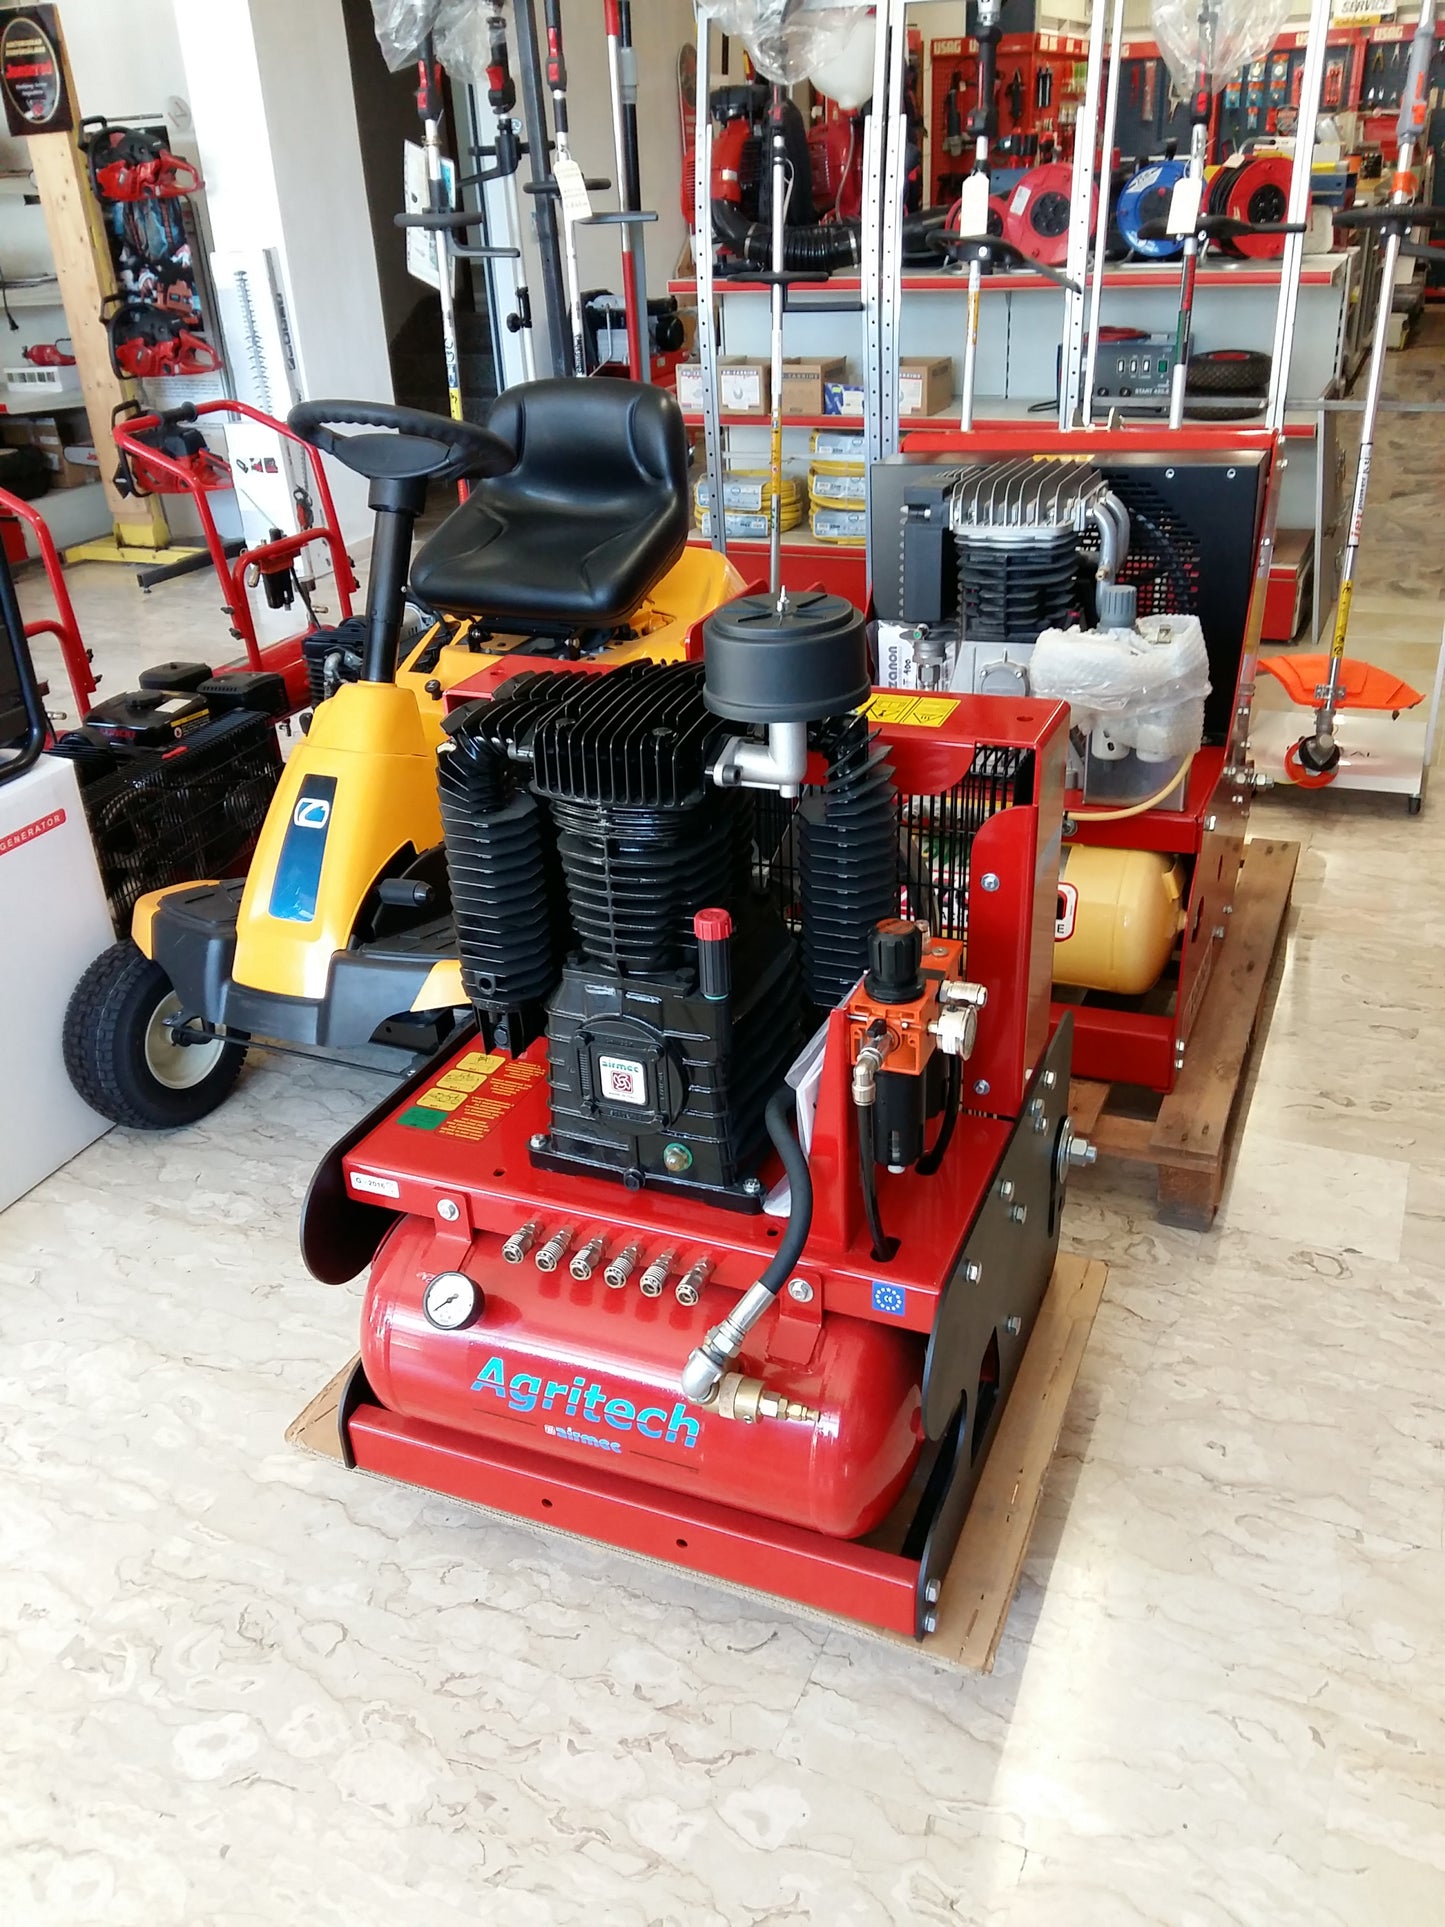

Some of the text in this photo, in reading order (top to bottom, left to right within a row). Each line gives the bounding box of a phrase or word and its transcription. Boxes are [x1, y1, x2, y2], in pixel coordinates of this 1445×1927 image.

[933, 40, 961, 55] USAG
[888, 646, 898, 687] zanon
[0, 815, 61, 851] GENERATOR
[601, 1060, 640, 1073] airmec
[470, 1356, 700, 1448] Agritech
[555, 1427, 622, 1453] airmec
